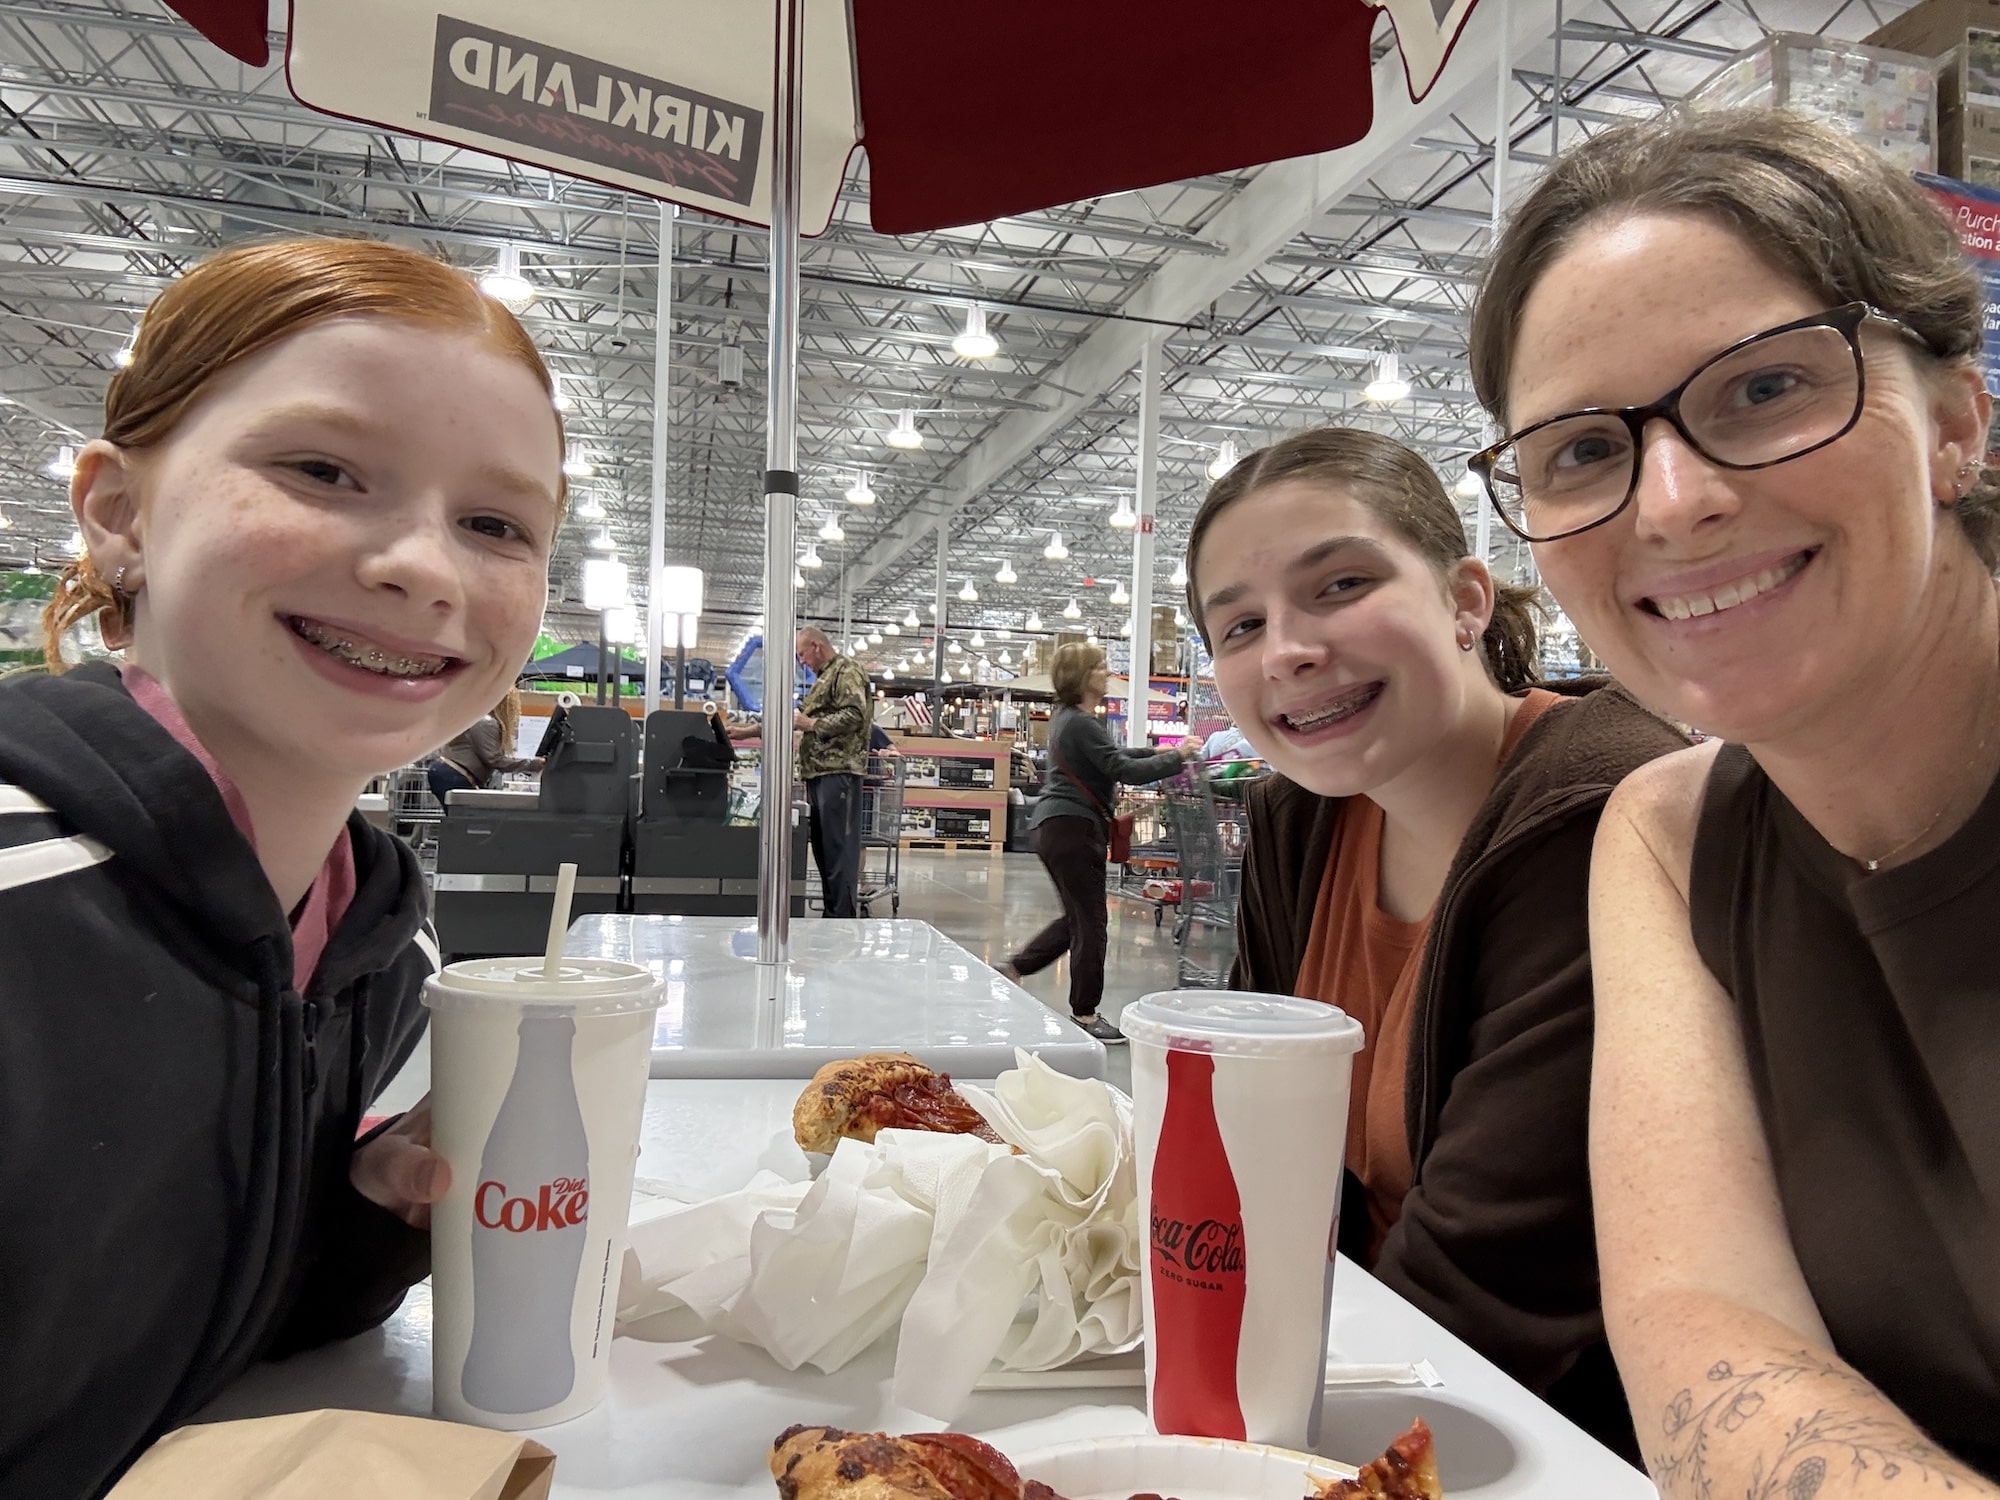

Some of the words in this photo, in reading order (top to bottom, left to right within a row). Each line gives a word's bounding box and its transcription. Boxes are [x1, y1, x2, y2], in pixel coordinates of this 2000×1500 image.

[553, 1177, 586, 1195] Diet
[475, 1181, 588, 1233] Coke
[1160, 1267, 1183, 1283] ZERO
[1186, 1278, 1223, 1292] SUGAR
